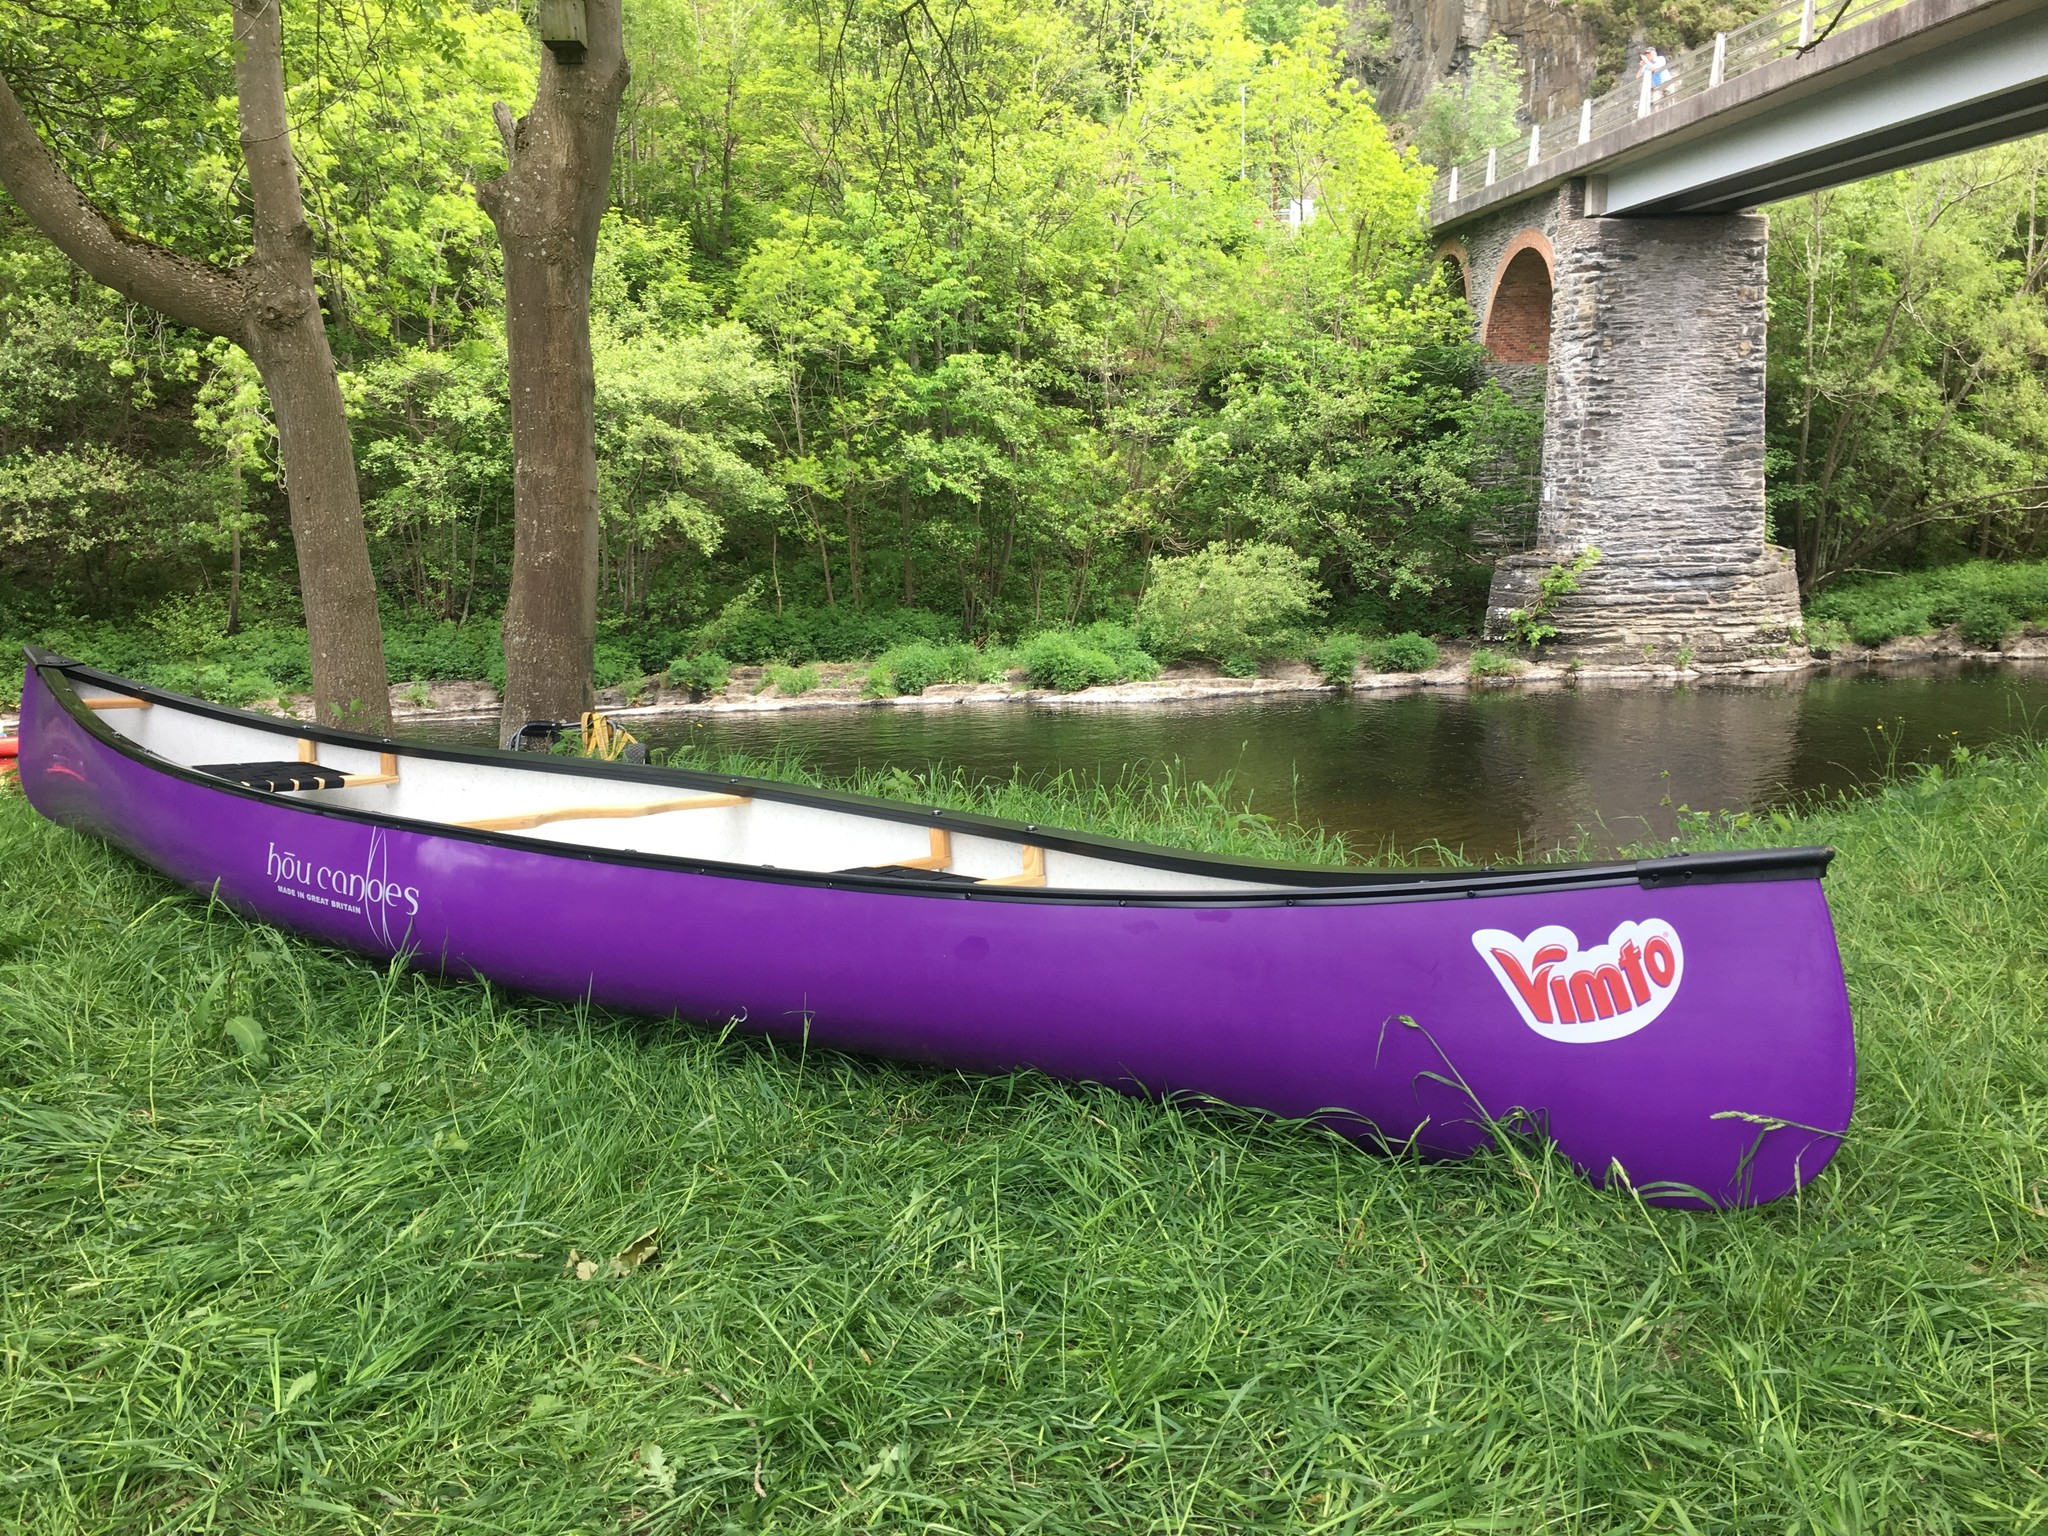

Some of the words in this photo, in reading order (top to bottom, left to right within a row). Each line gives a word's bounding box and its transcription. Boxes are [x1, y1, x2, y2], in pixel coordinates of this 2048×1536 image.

[278, 885, 296, 897] MADE
[297, 890, 305, 899] IN
[306, 893, 329, 906] GREAT
[331, 900, 361, 914] BRITAIN
[317, 867, 419, 915] canoes
[1490, 935, 1675, 1024] Vimto
